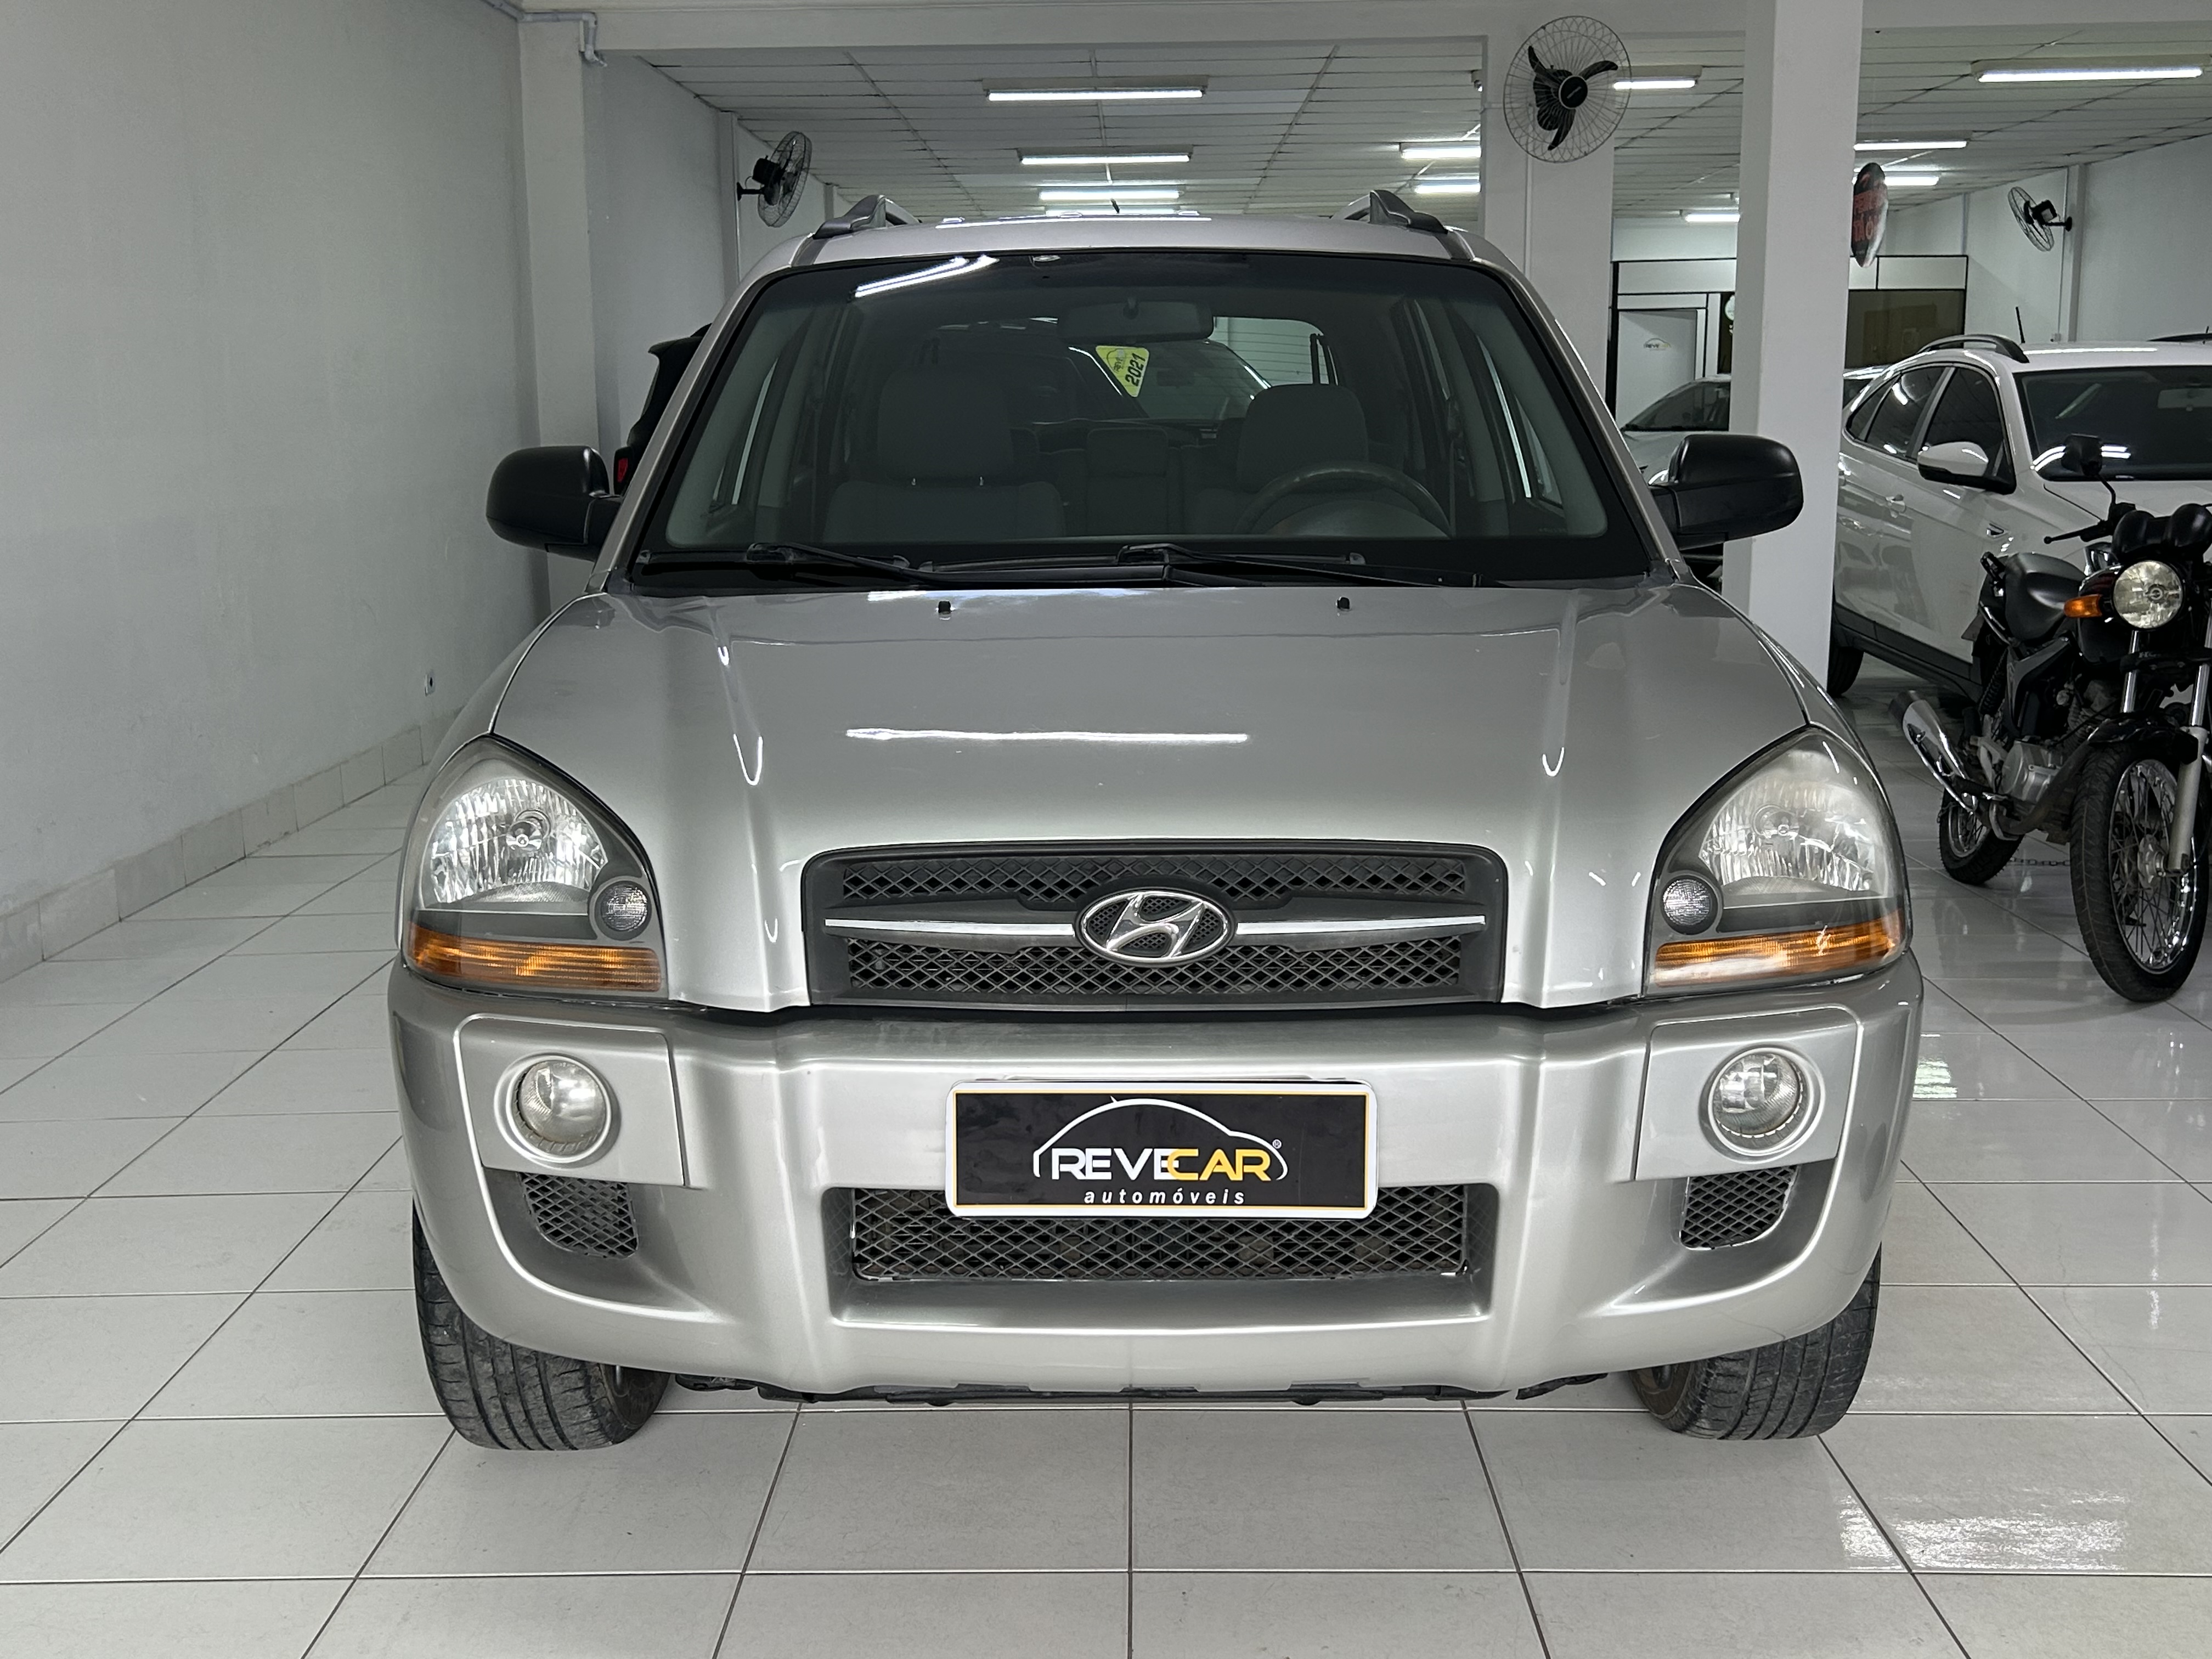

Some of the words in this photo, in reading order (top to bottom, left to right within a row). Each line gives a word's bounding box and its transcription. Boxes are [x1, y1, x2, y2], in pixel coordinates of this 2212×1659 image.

[1125, 353, 1146, 387] 2021
[1052, 1148, 1271, 1181] REVECAR
[1084, 1187, 1244, 1205] automóveis
